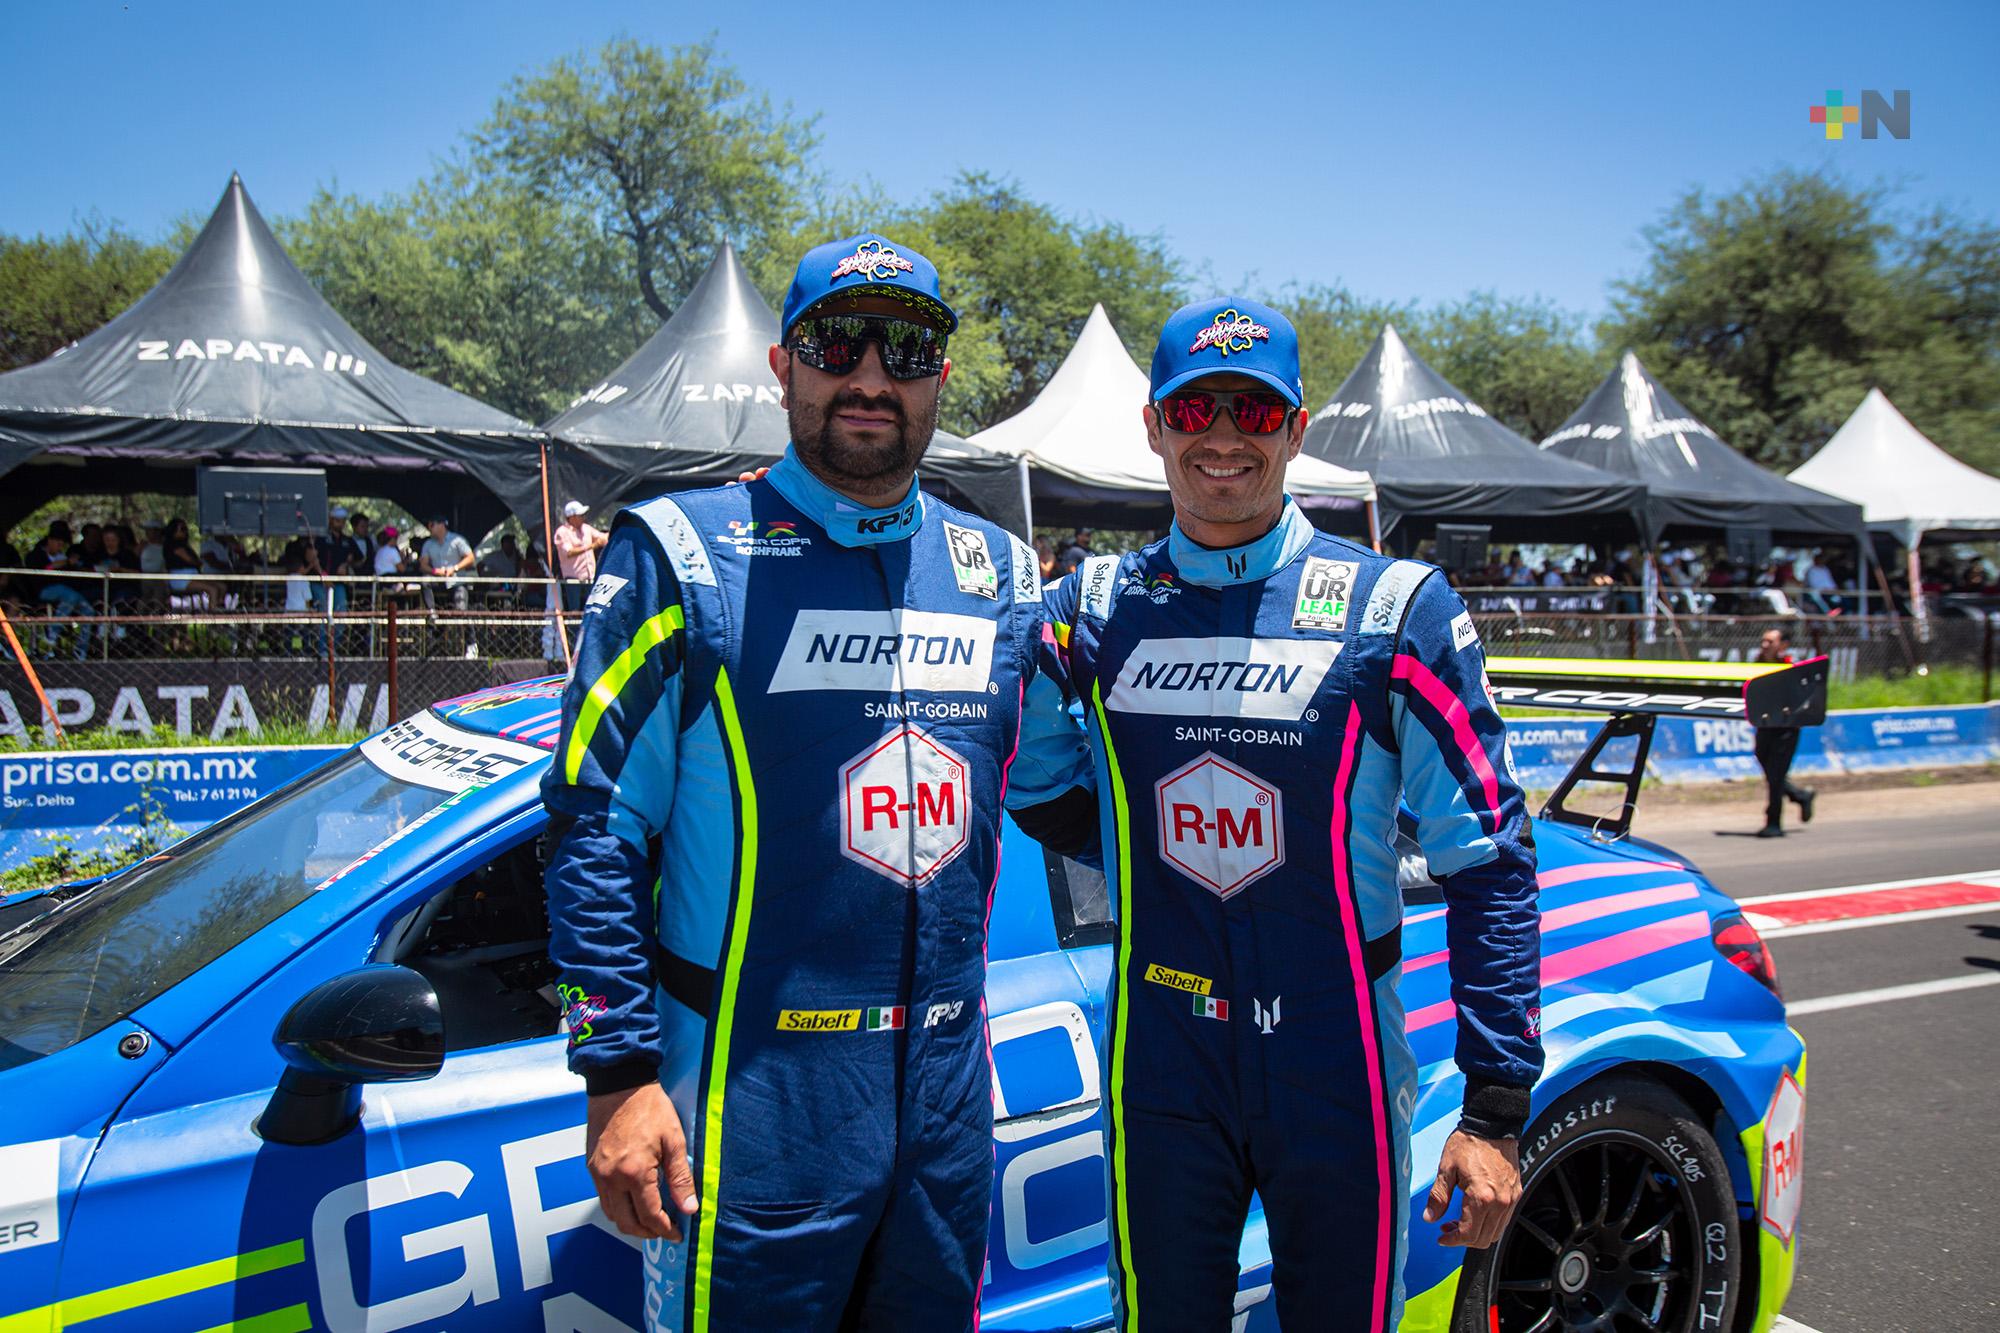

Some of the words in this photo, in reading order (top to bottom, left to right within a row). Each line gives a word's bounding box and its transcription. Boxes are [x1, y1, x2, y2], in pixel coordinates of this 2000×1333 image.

[1190, 322, 1270, 352] SHAMROCK
[137, 339, 315, 368] ZAPATA
[771, 537, 811, 546] COPA
[1091, 562, 1110, 607] Sabelt
[1300, 600, 1345, 616] LEAF
[806, 634, 975, 665] NORTON
[1131, 661, 1304, 693] NORTON
[864, 701, 987, 719] SAINT-GOBAIN
[1175, 726, 1302, 746] SAINT-GOBAIN
[3, 757, 257, 794] prisa.com.mx
[36, 793, 75, 807] Delta
[861, 782, 955, 832] R-M
[1172, 803, 1264, 848] R-M
[1152, 967, 1205, 993] Sabelt
[786, 1011, 852, 1029] Sabelt
[1520, 1096, 1618, 1174] Hoosier
